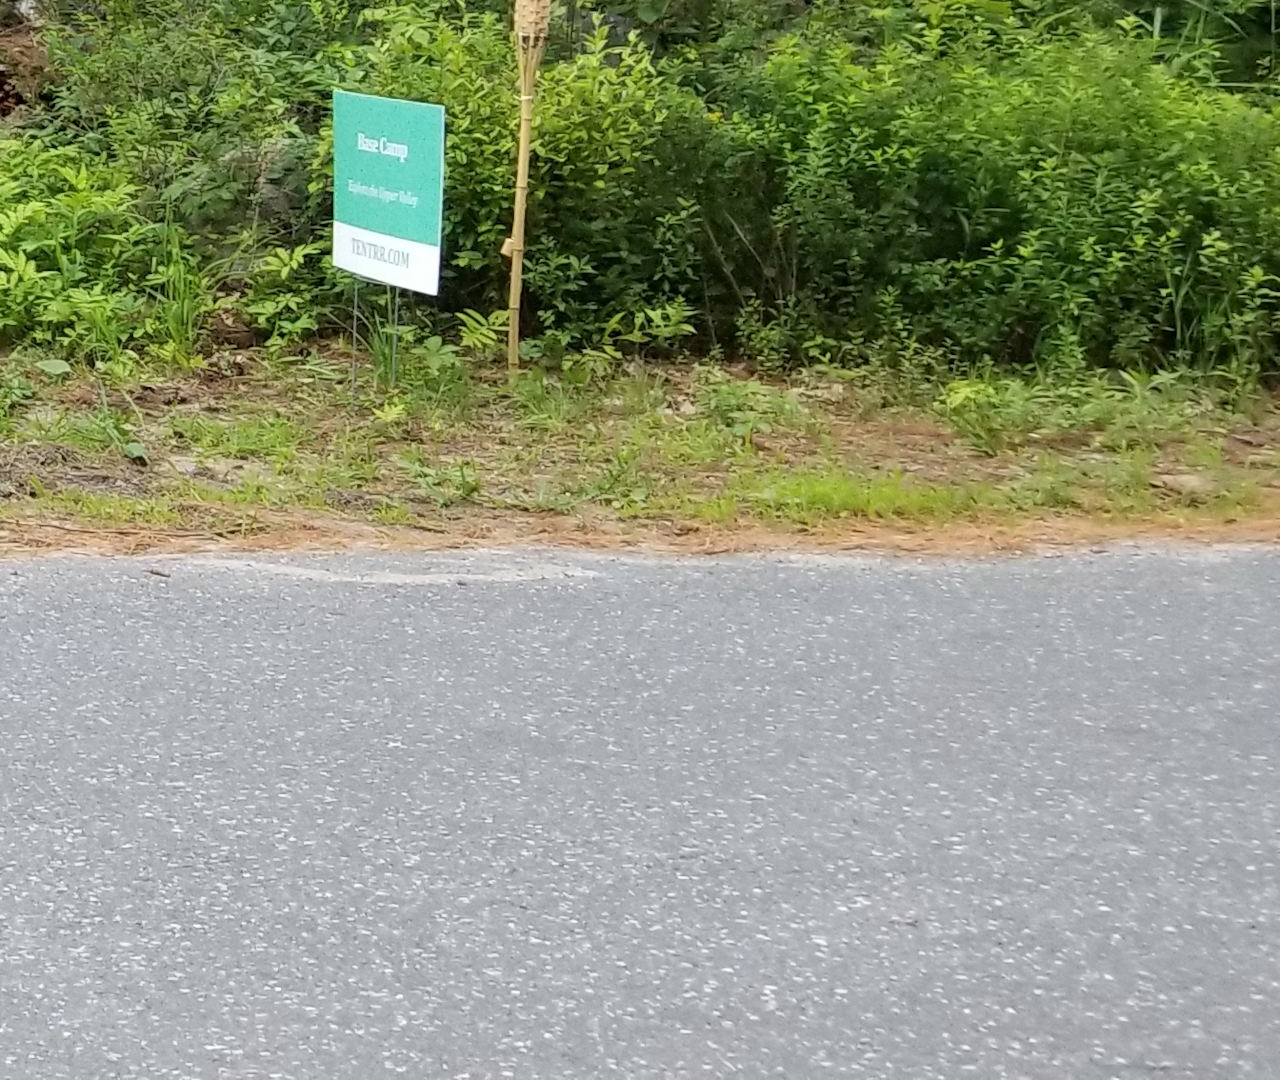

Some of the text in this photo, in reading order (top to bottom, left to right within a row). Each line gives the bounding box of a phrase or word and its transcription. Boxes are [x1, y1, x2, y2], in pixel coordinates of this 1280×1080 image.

[357, 132, 409, 163] Base Camp
[351, 237, 410, 268] TENTRR.COM
